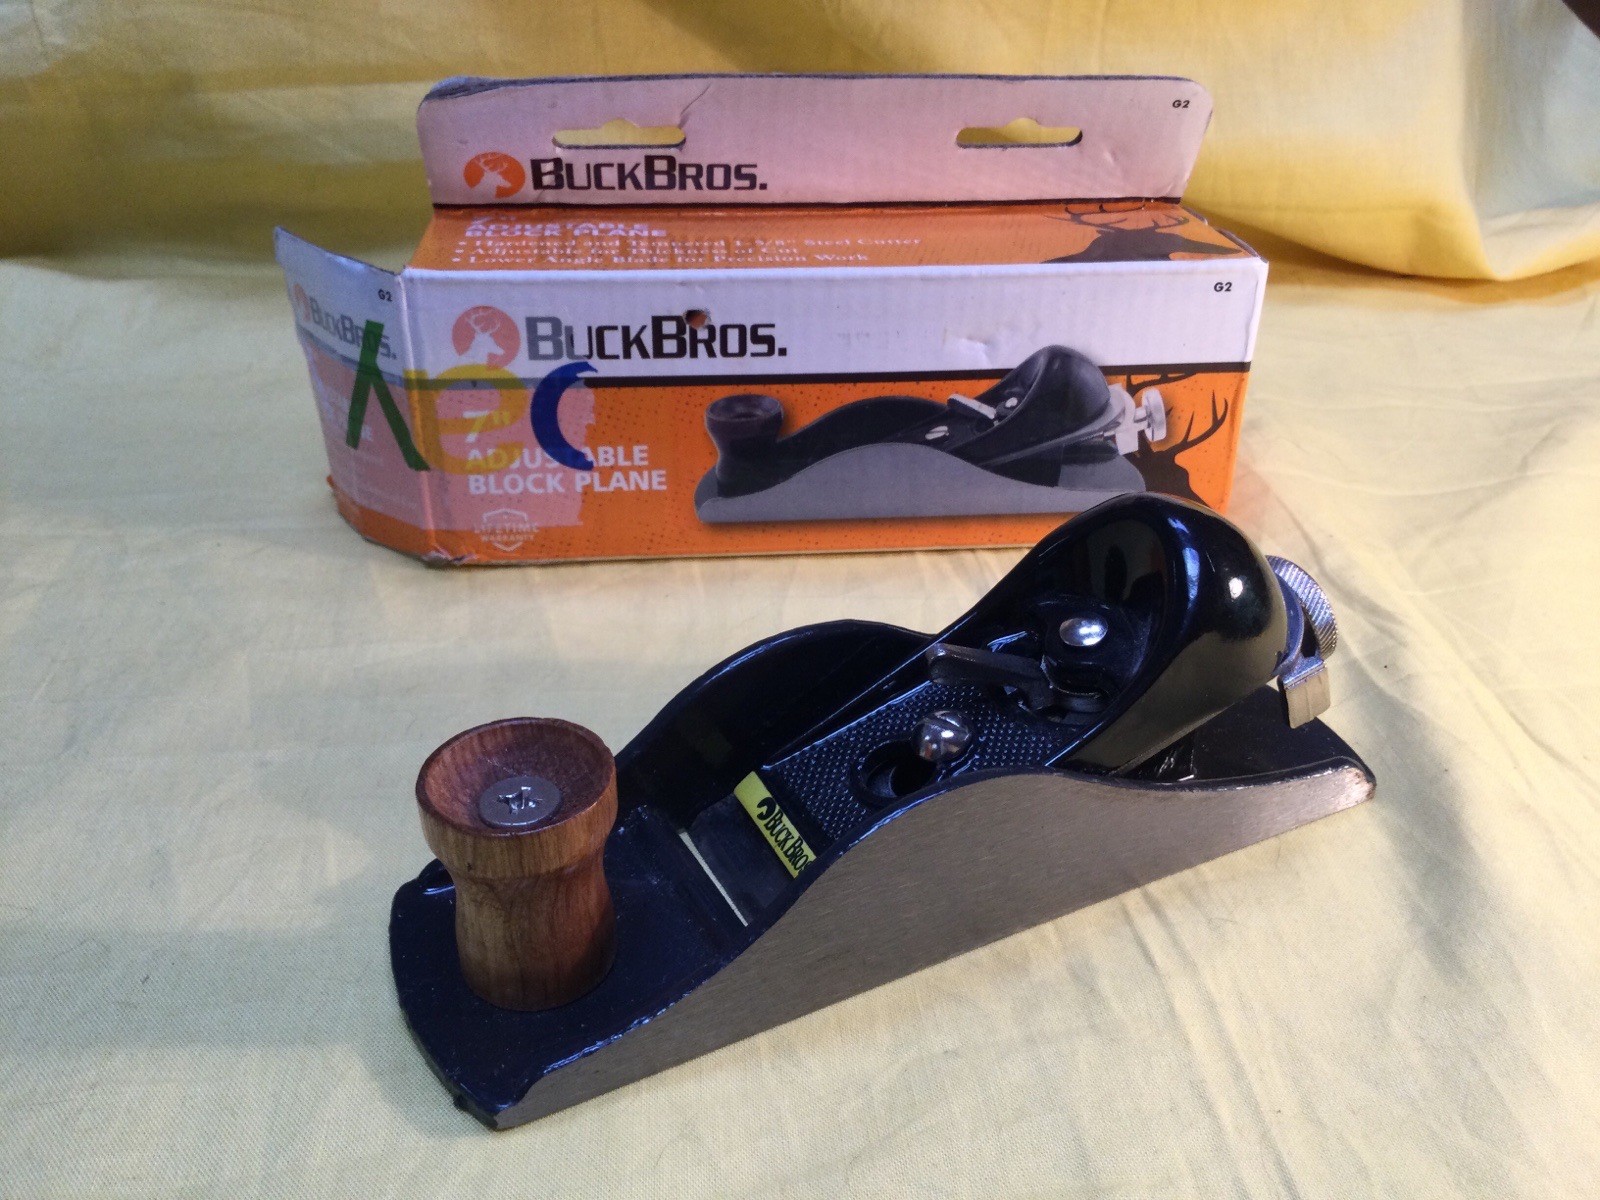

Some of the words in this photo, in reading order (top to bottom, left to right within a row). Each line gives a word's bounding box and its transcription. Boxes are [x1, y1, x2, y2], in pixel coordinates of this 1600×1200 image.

[1172, 100, 1190, 109] G2
[814, 253, 869, 262] Work
[1214, 281, 1232, 293] G2
[378, 288, 393, 302] G2
[468, 472, 565, 495] BLOCK
[575, 469, 667, 493] PLANE
